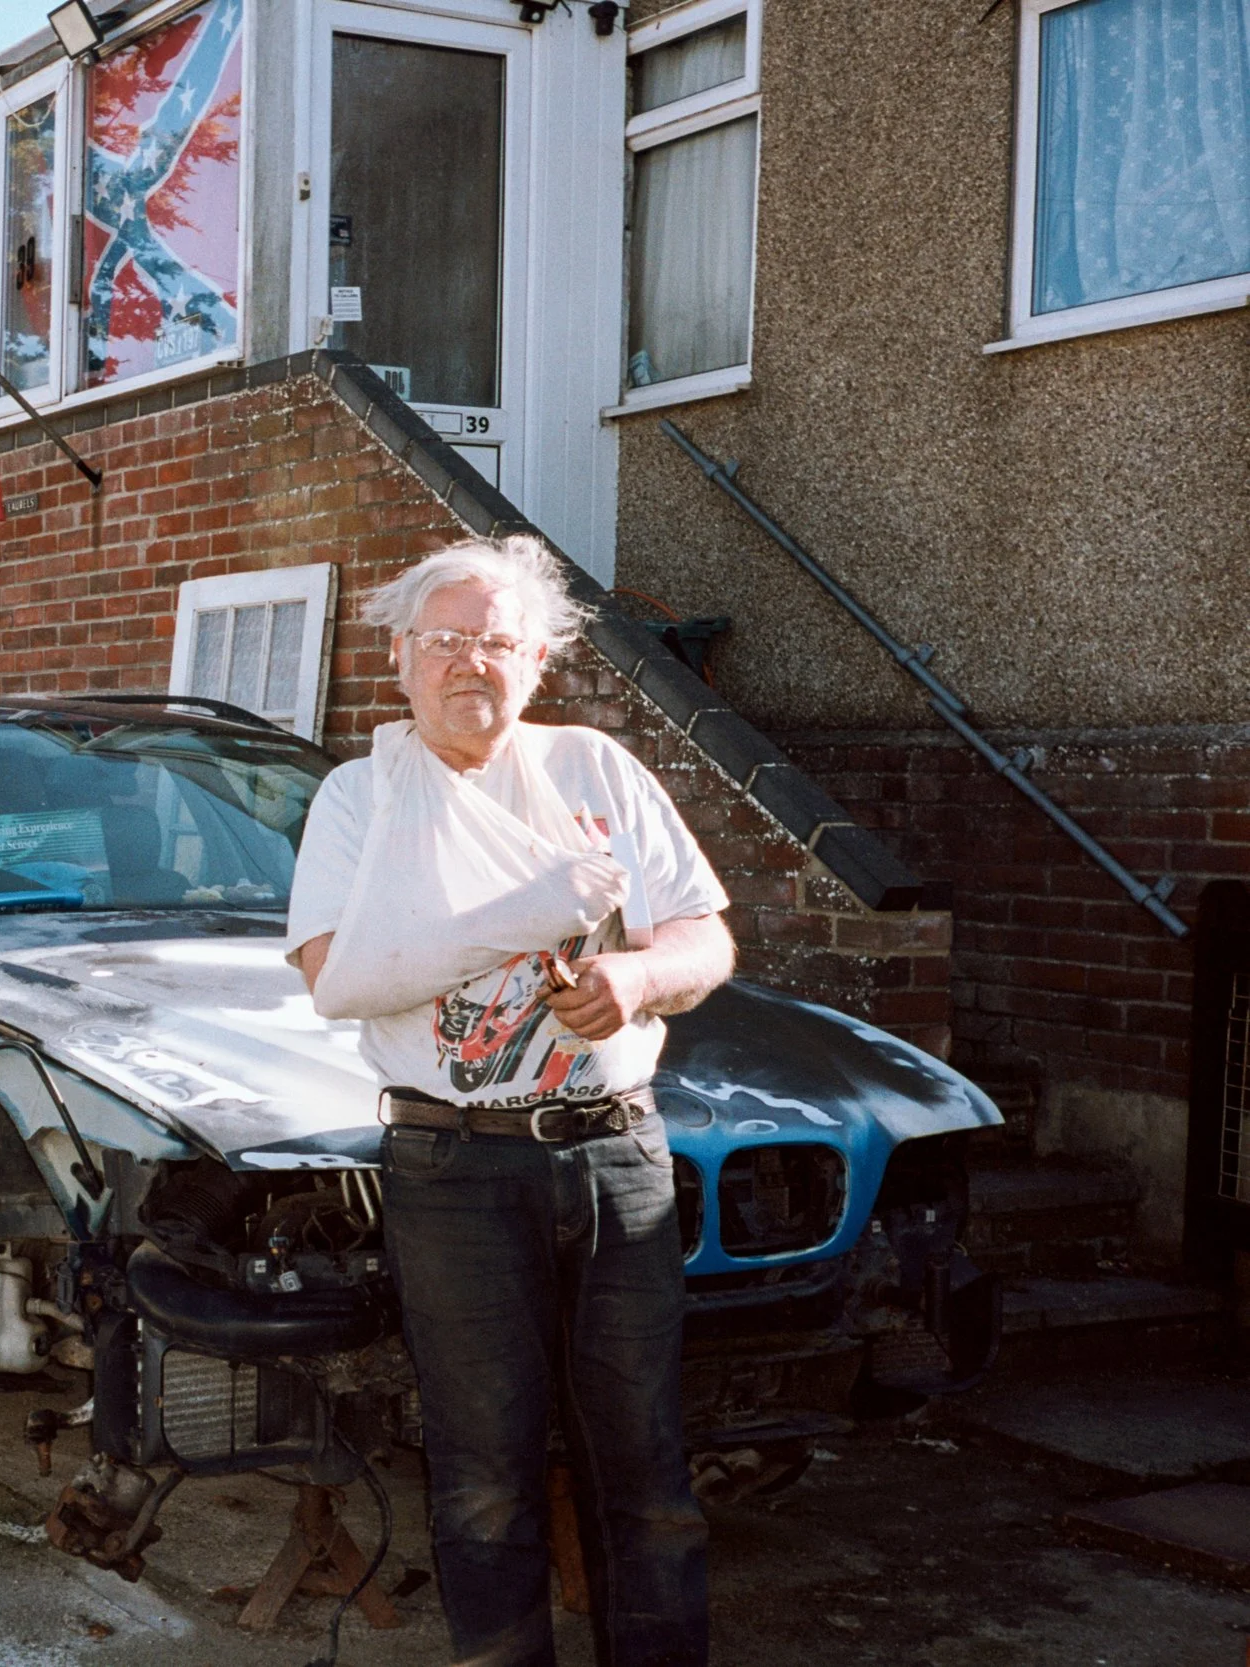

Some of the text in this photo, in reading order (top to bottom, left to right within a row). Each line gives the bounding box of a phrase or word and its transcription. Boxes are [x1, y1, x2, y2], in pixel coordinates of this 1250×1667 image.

[466, 416, 489, 433] 39
[7, 497, 35, 513] LAURELS
[467, 1088, 558, 1108] MARCH
